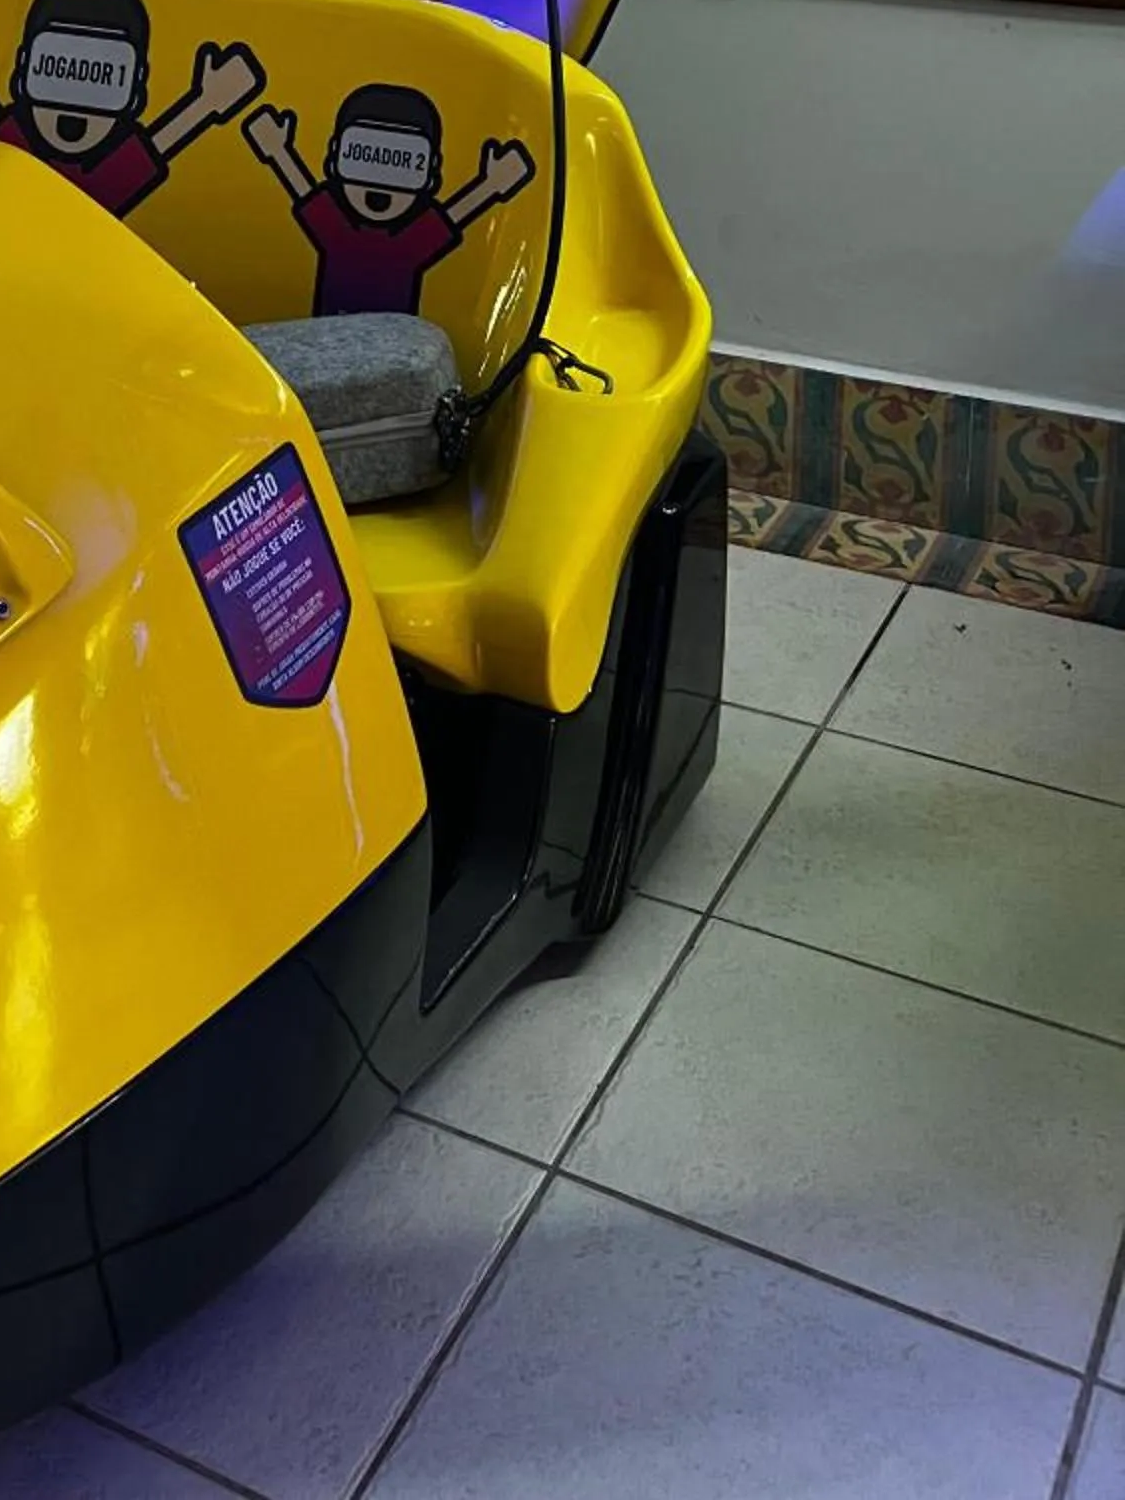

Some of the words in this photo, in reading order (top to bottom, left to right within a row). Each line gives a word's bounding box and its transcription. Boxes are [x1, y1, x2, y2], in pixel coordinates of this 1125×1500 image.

[32, 53, 113, 86] JOGADOR
[117, 59, 127, 88] 1
[341, 142, 412, 169] JOGADOR
[415, 155, 426, 171] 2
[212, 471, 279, 541] ATENÇÃO
